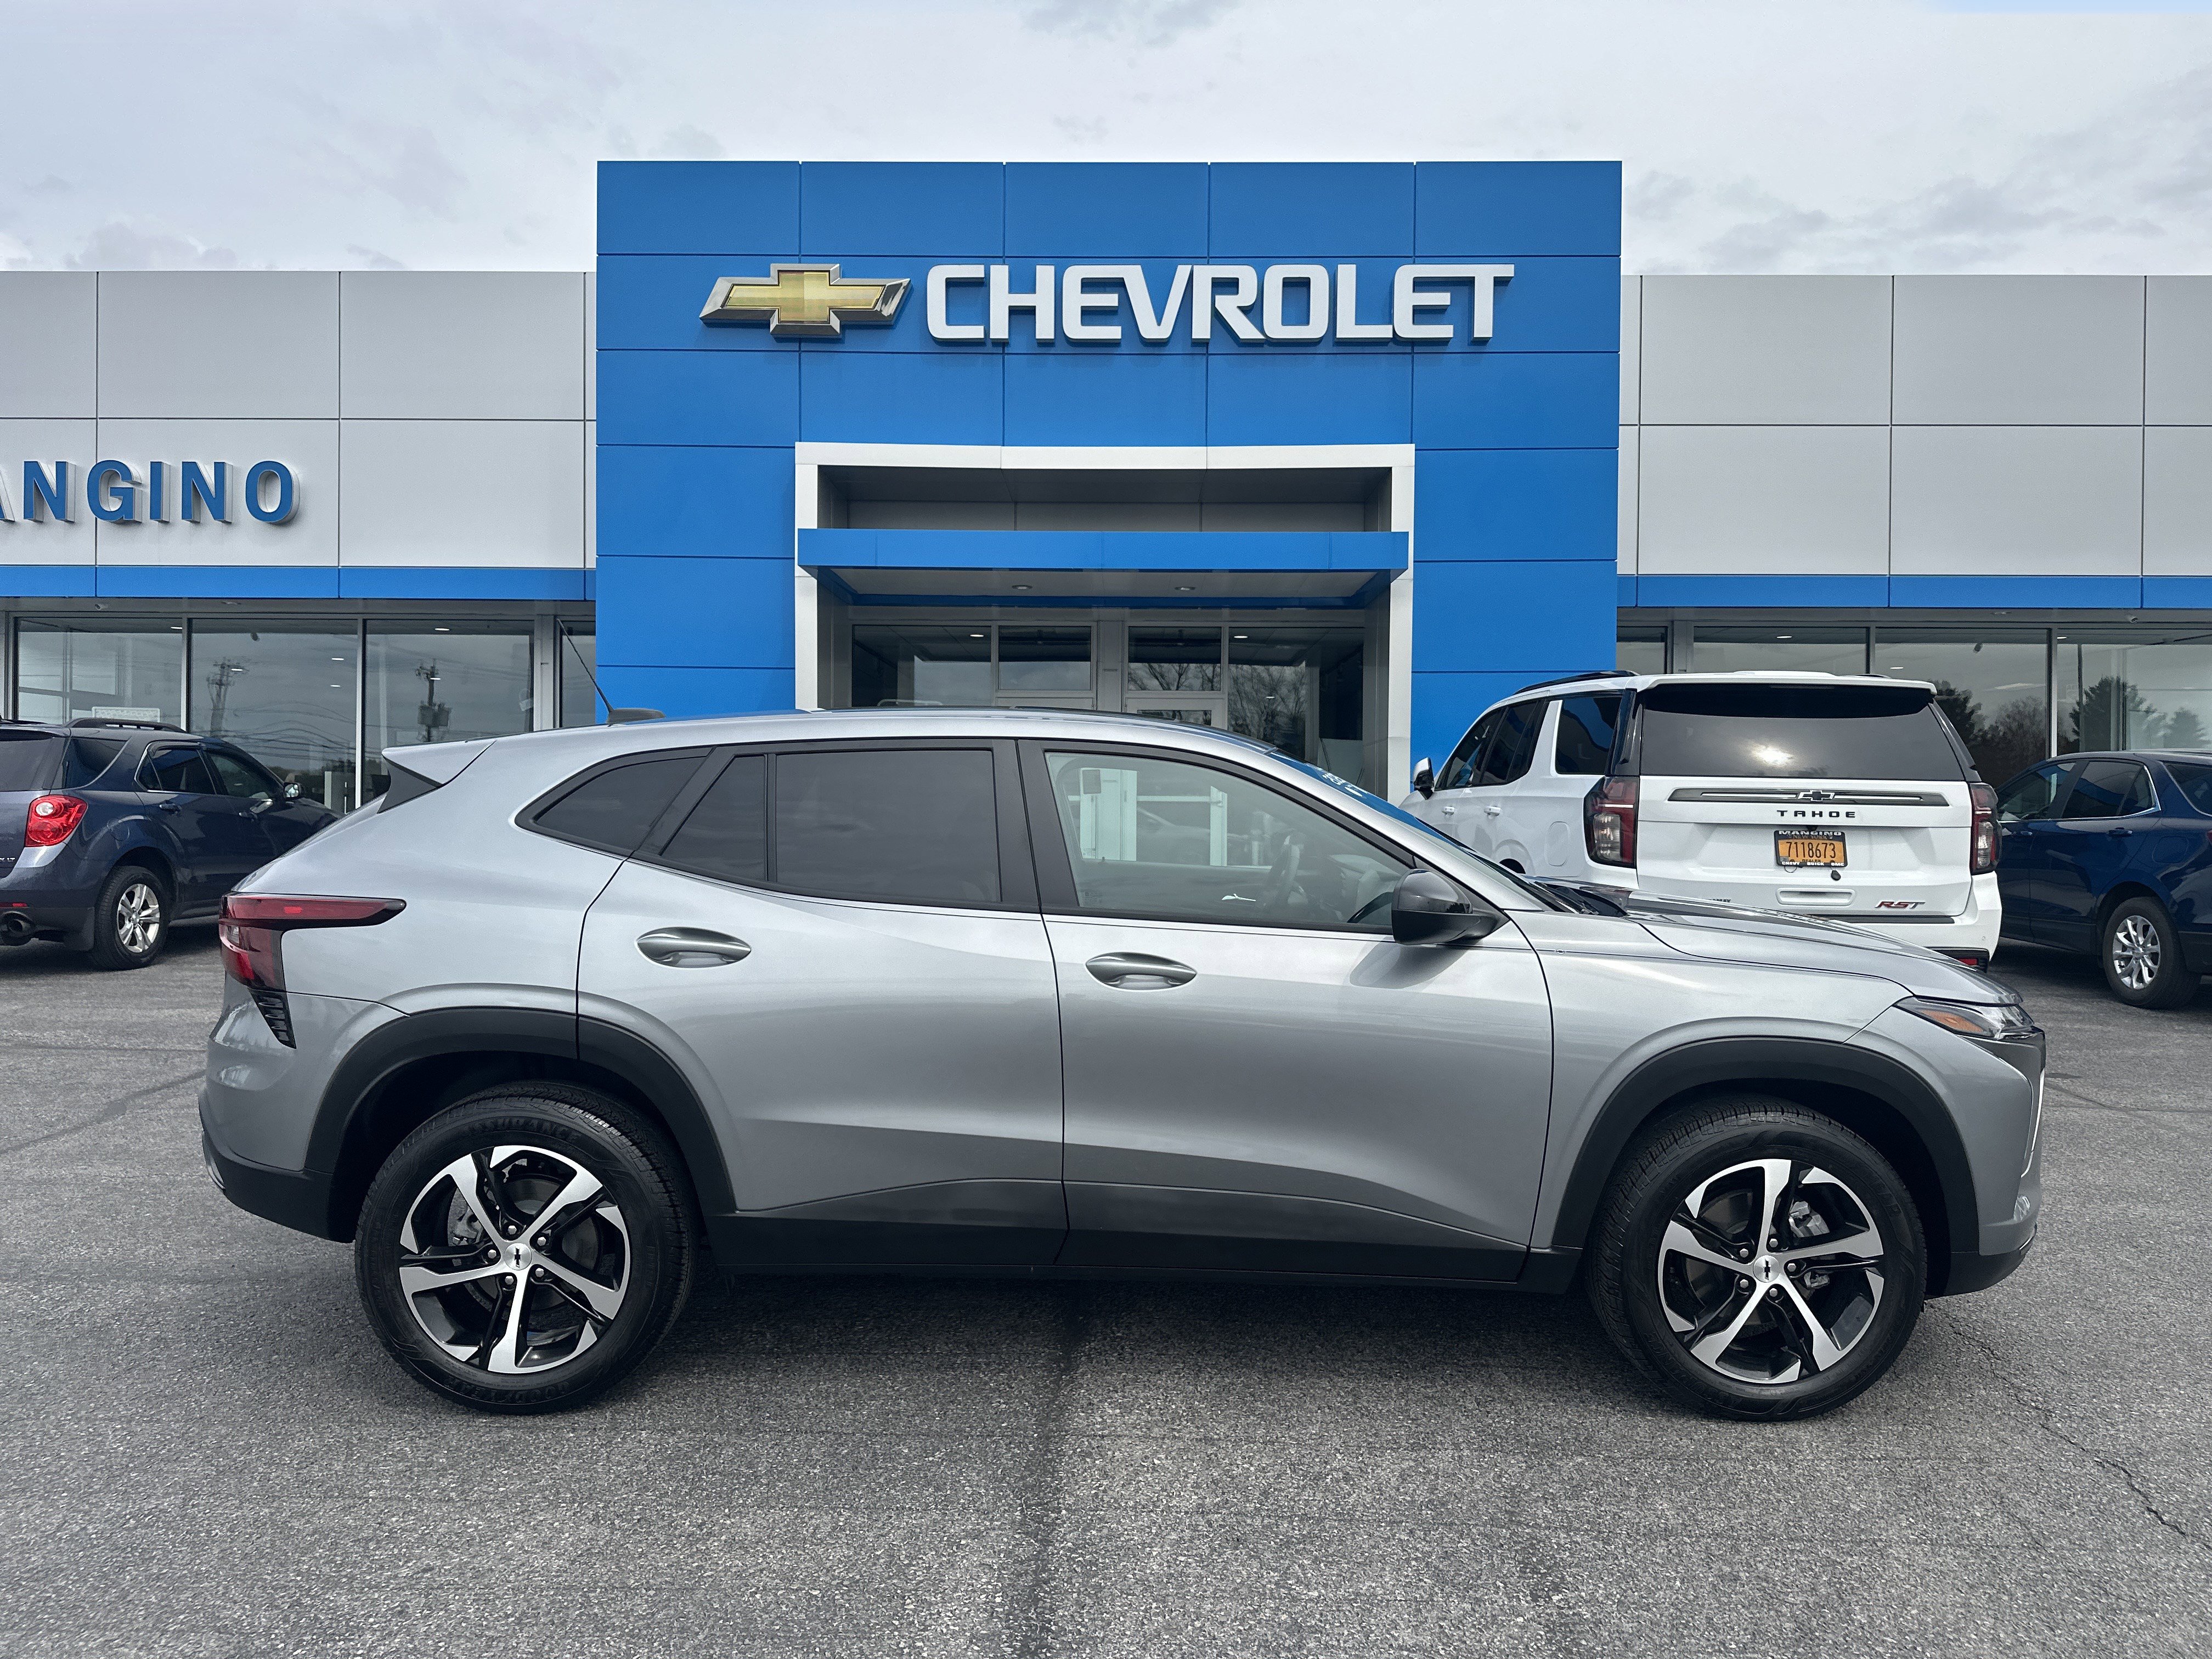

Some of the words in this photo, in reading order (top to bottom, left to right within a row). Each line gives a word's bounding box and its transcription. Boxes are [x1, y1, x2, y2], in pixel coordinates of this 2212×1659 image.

[926, 263, 1515, 344] CHEVROLET
[0, 459, 301, 524] NGINO
[1777, 810, 1855, 818] TAHOE
[1786, 842, 1836, 859] 7118673
[1875, 901, 1926, 909] RST
